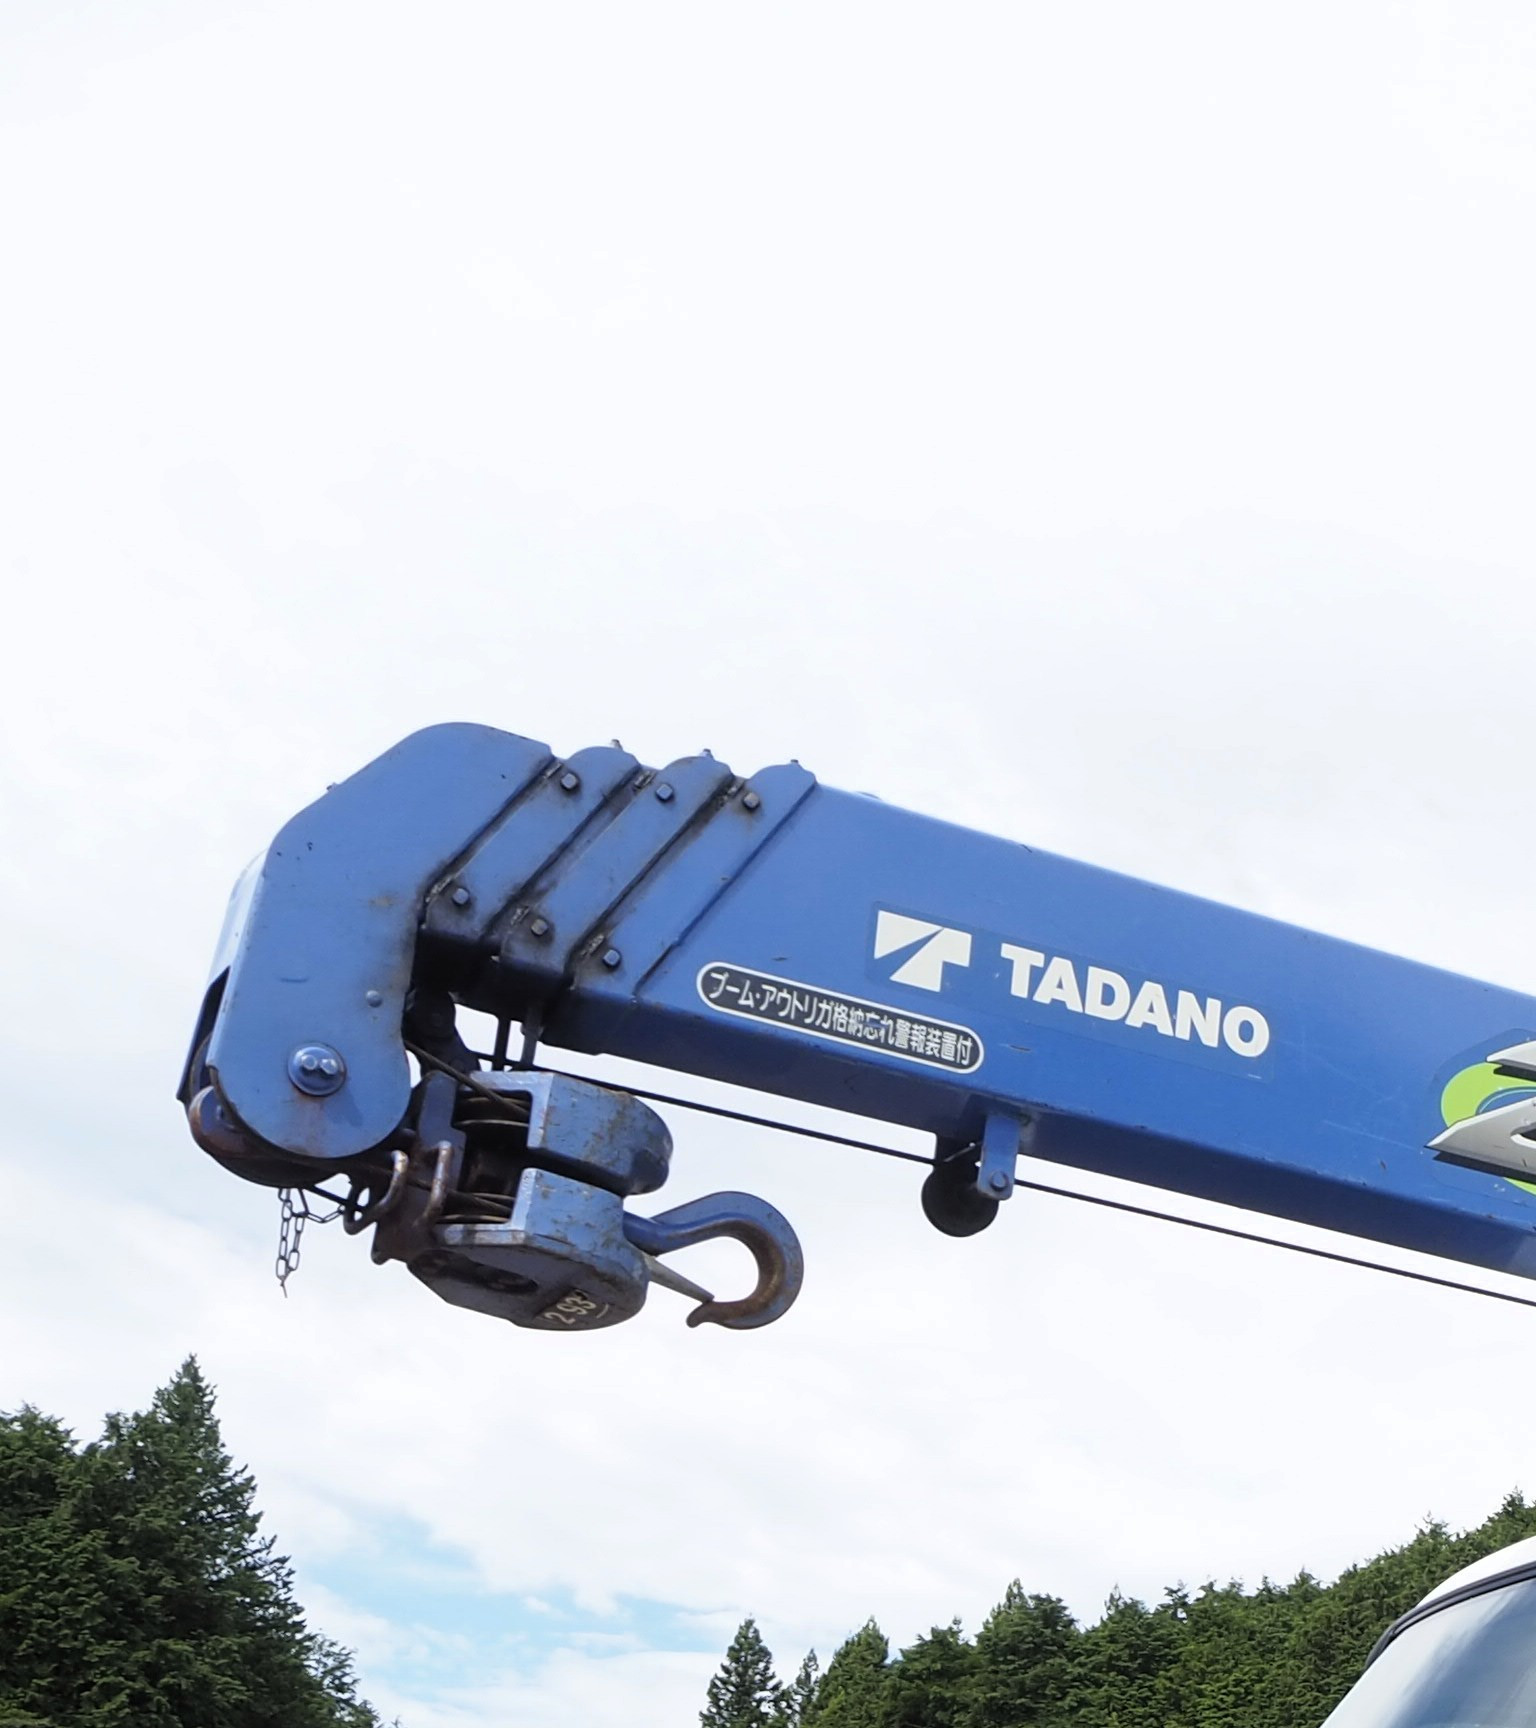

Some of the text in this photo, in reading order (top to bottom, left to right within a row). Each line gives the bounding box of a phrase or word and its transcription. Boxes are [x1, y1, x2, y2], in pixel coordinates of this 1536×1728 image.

[709, 971, 973, 1066] ブーム・アウトリガ格納忘れ警報装置付
[1000, 943, 1270, 1058] TADANO
